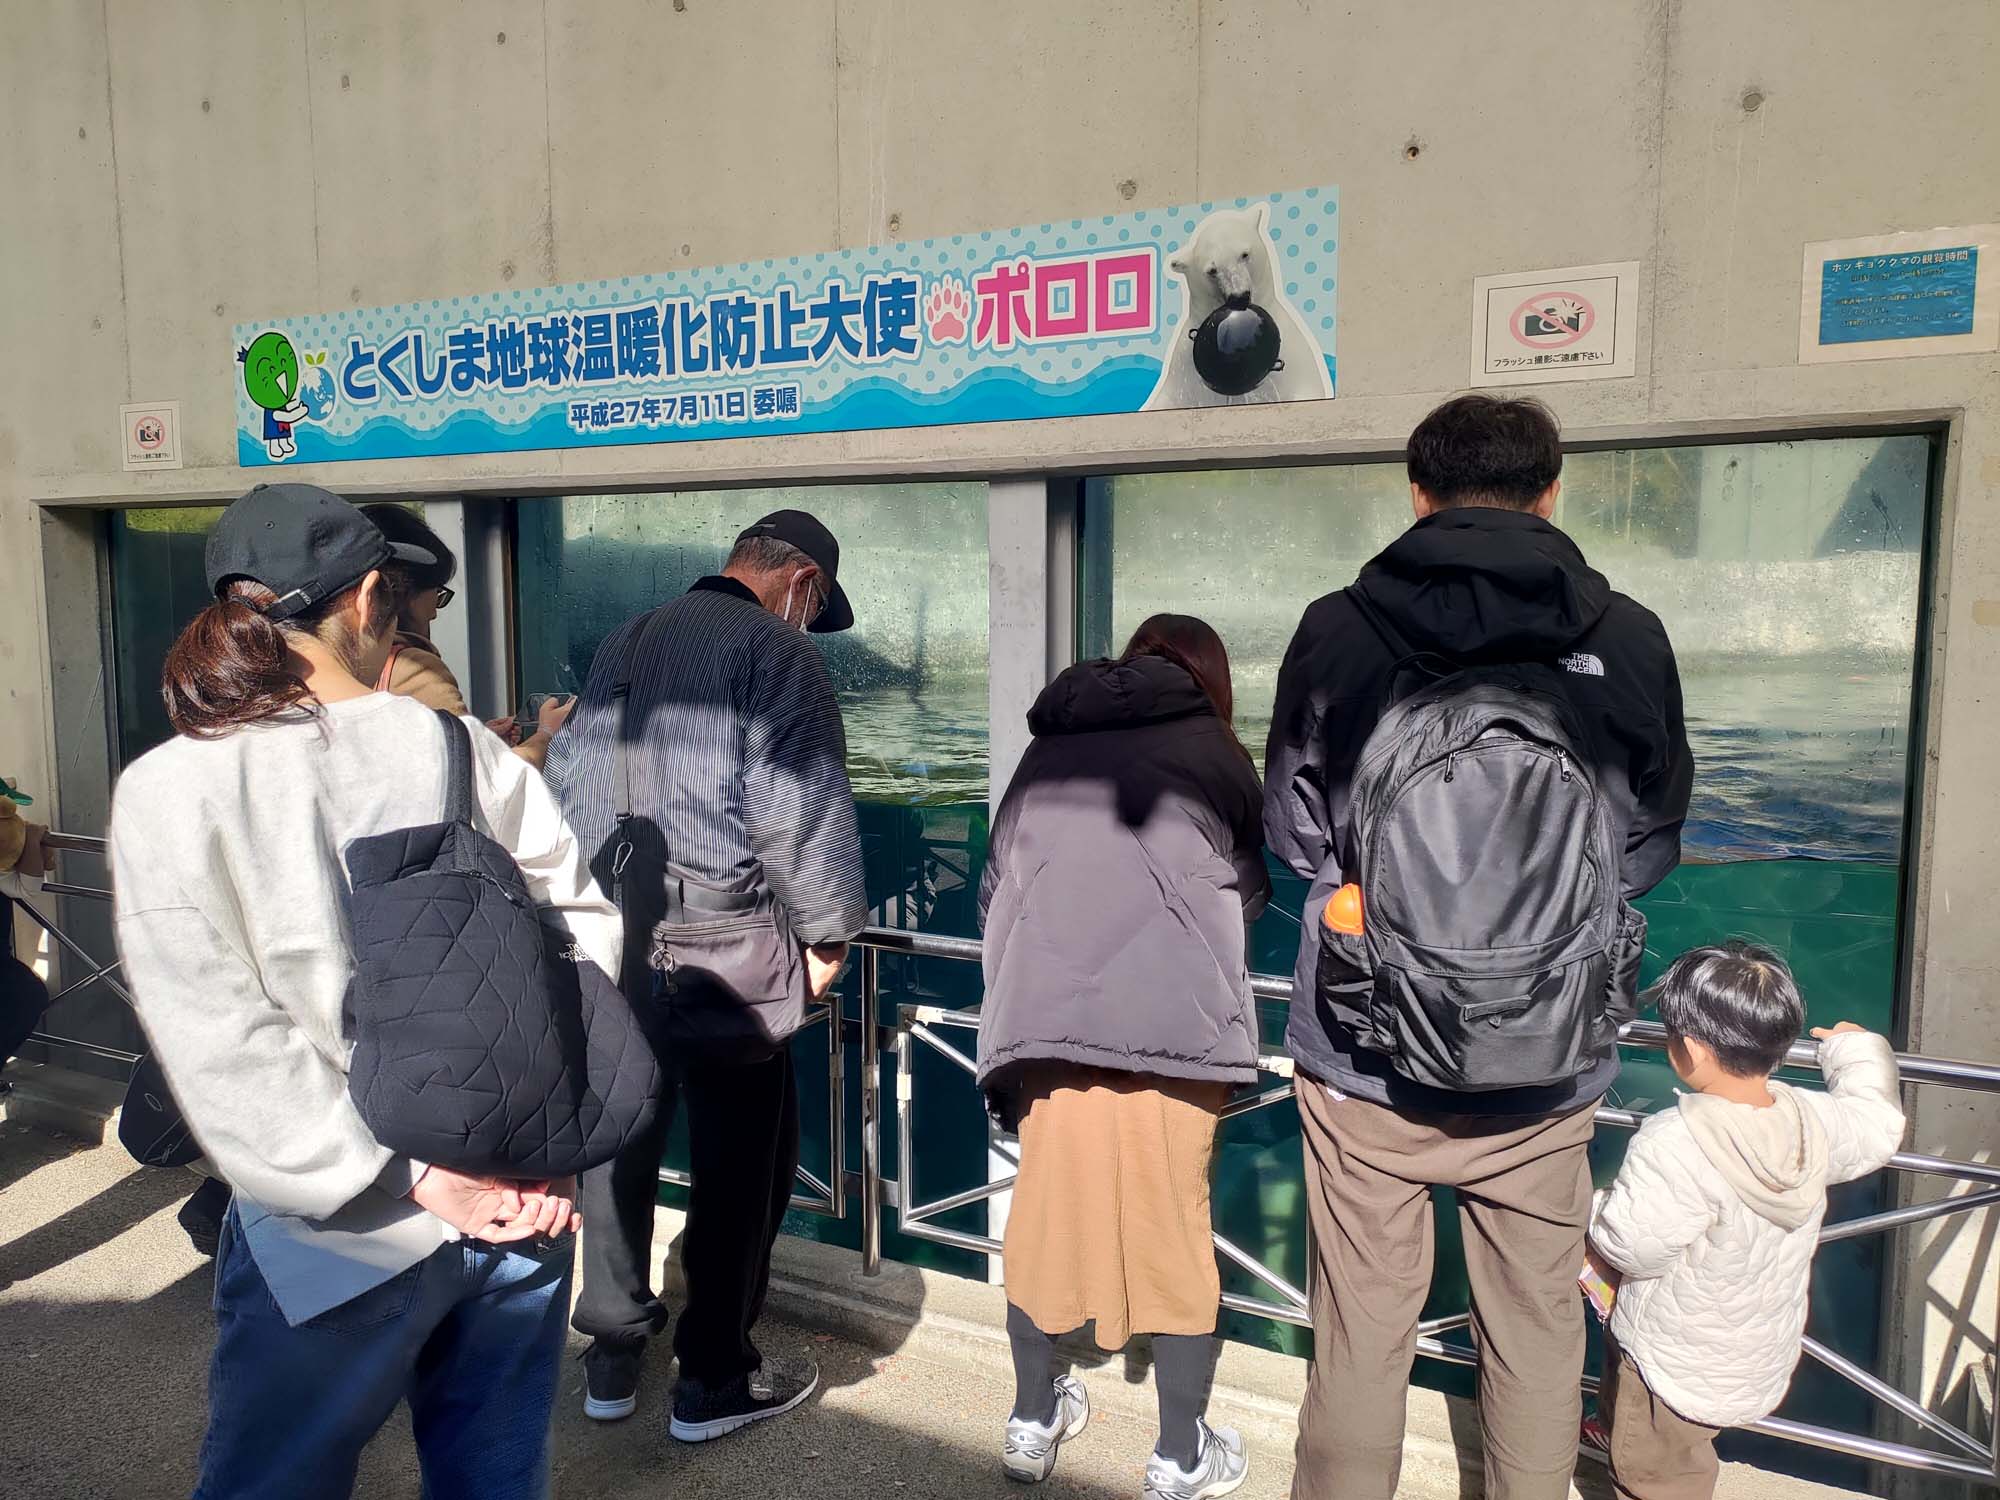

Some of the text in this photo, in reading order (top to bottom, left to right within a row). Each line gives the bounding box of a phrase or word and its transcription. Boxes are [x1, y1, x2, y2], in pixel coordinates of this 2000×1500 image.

[343, 254, 1151, 398] とくしま地球温暖化防止大使 ポロロ
[1494, 351, 1604, 367] フラッシュ撮影ご遠慮下さい
[571, 387, 798, 427] 平成27年7月11日 委嘱
[1558, 657, 1589, 667] NORTH
[1572, 652, 1589, 661] THE
[1567, 665, 1589, 674] FACE
